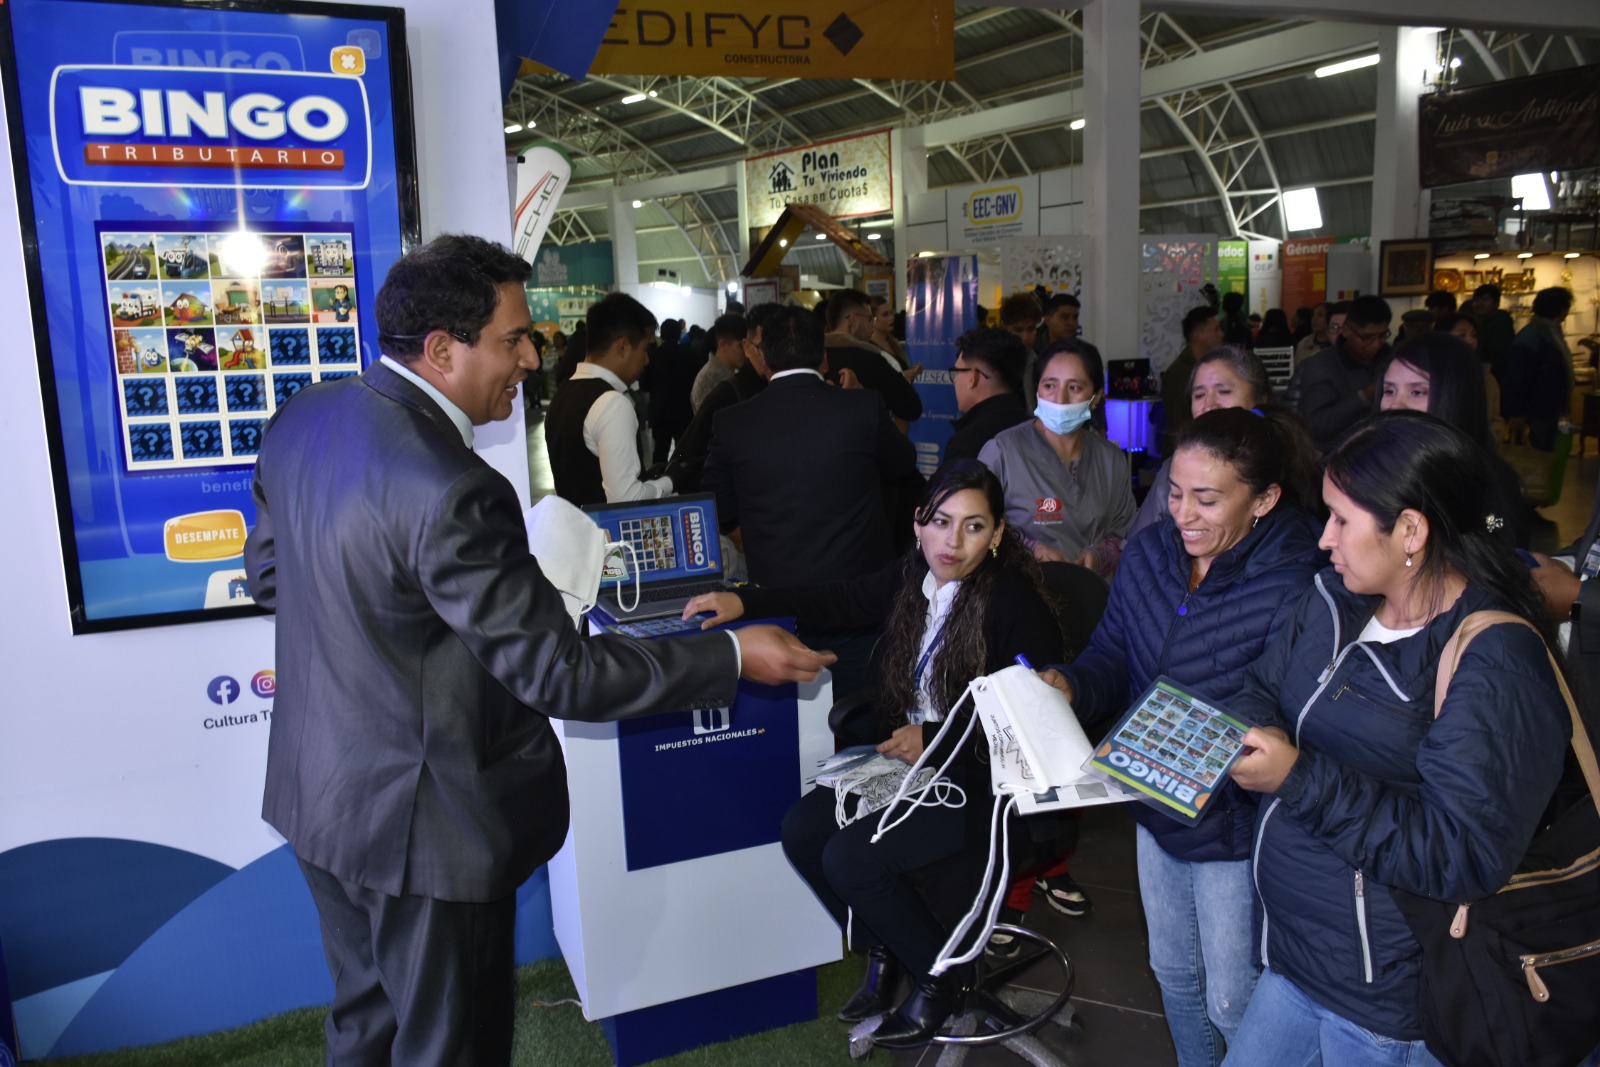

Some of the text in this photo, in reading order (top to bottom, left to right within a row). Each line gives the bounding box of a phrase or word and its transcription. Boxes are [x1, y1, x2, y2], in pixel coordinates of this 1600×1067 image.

[724, 54, 811, 65] CONSTRUCTORA
[79, 86, 348, 142] BINGO
[97, 146, 335, 164] TRIBUTARIO
[802, 151, 839, 173] Plan
[803, 166, 867, 186] Tu Vivienda
[770, 197, 781, 209] Tu
[813, 192, 826, 203] en
[973, 193, 1016, 219] EEC-GNV
[175, 528, 240, 544] DESEMPATE
[689, 511, 705, 566] BINGO
[203, 712, 258, 730] Cultura
[655, 728, 757, 752] IMPUESTOS NACIONALES
[1108, 750, 1198, 804] BINGO
